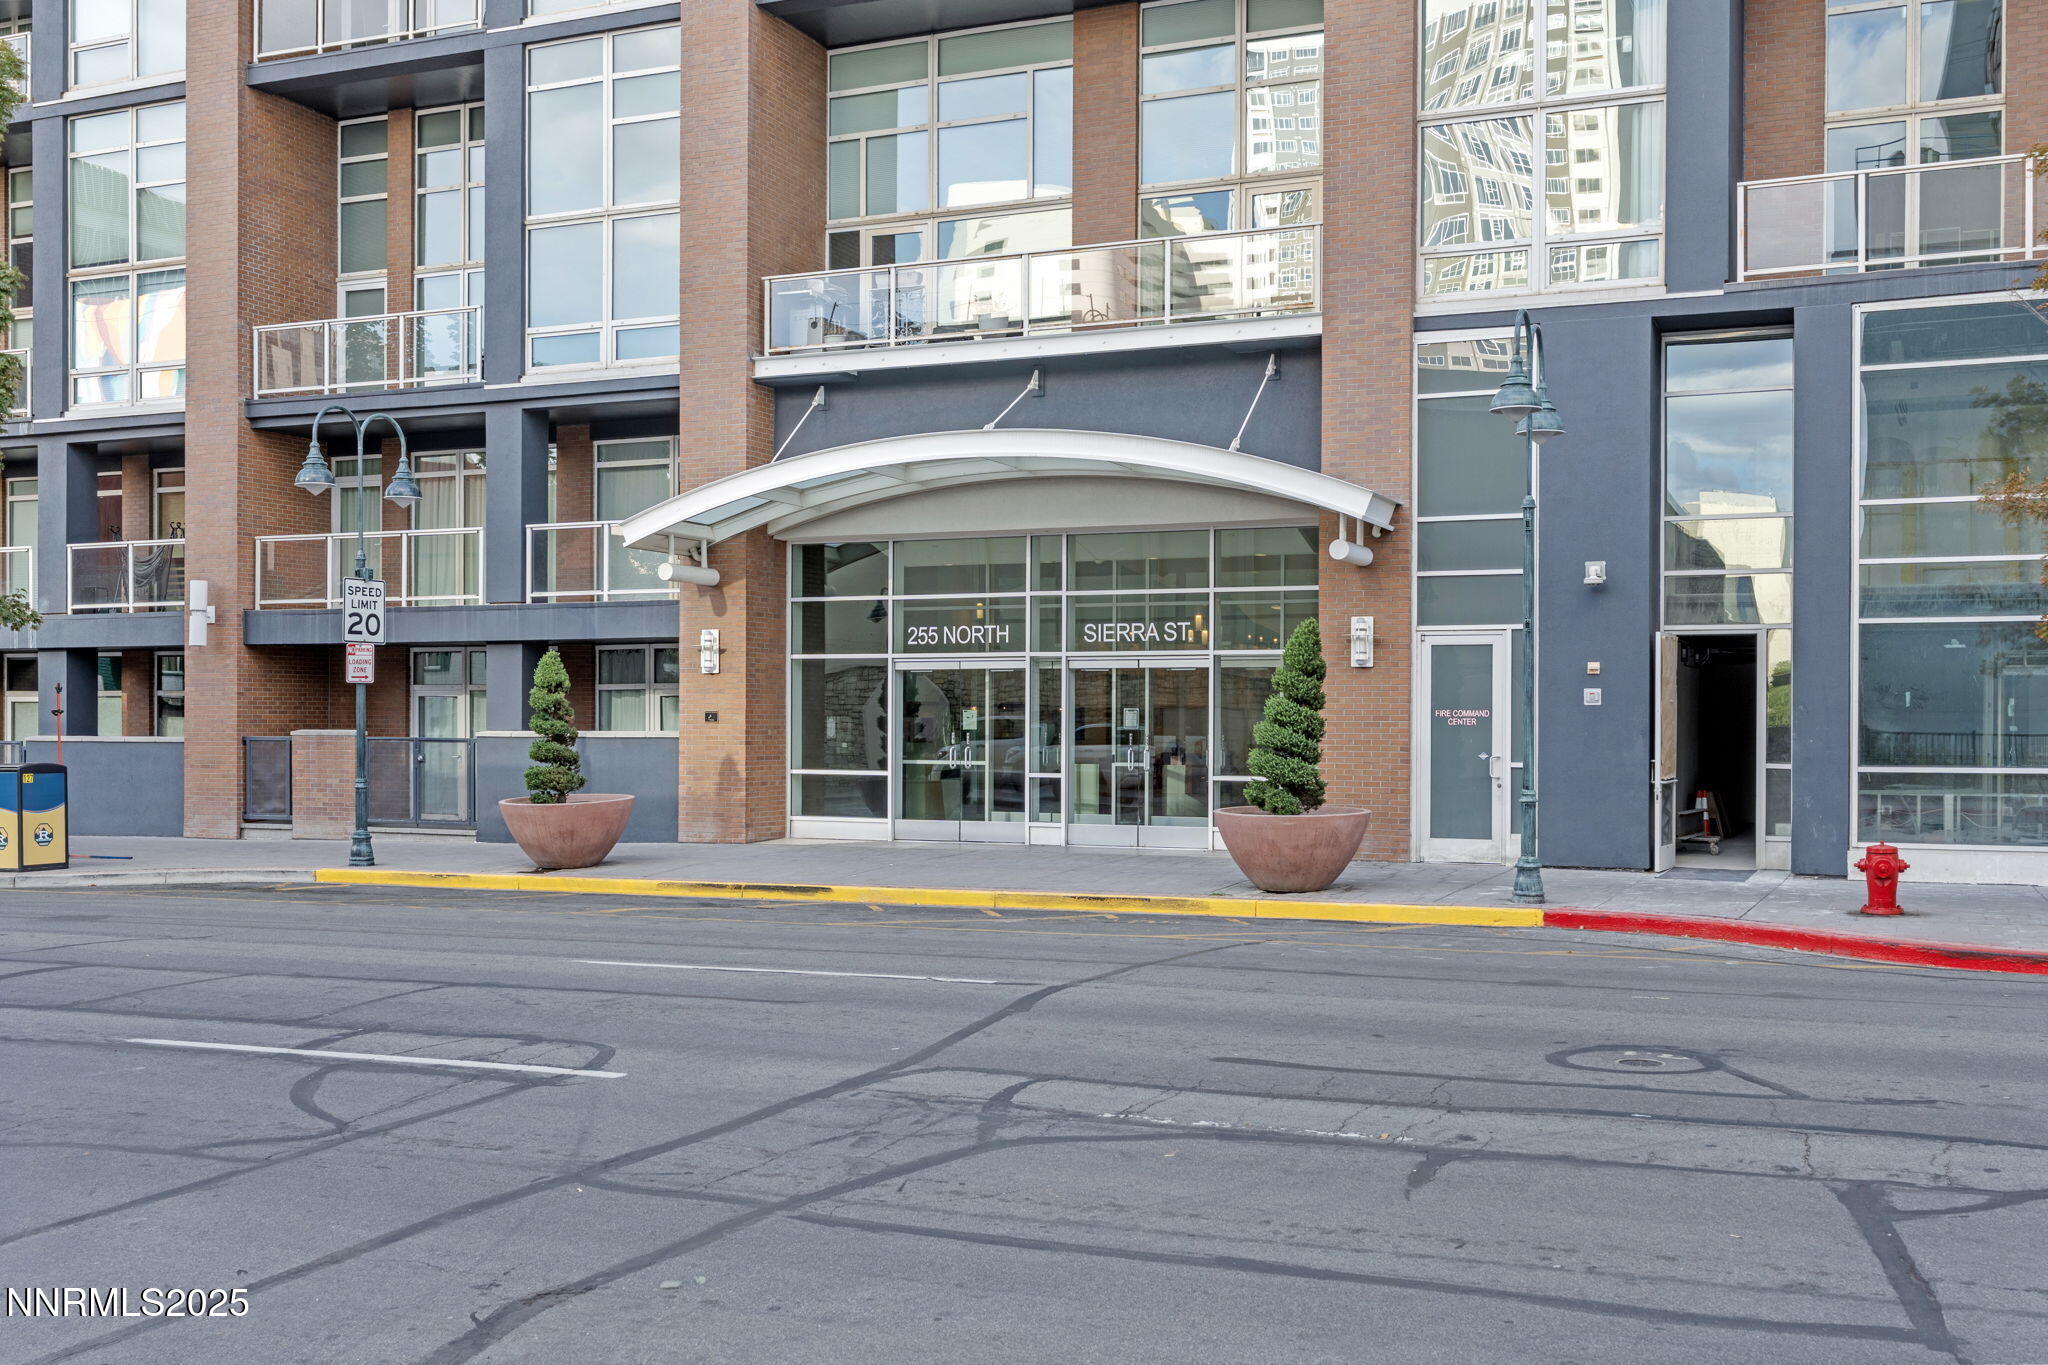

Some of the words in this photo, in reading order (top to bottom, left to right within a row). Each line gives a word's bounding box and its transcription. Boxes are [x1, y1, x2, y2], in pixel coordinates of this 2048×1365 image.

[347, 586, 382, 597] SPEED
[351, 599, 378, 610] LIMIT
[347, 612, 381, 636] 20
[1083, 622, 1160, 643] SIERRA
[907, 626, 938, 645] 255
[943, 625, 1009, 644] NORTH
